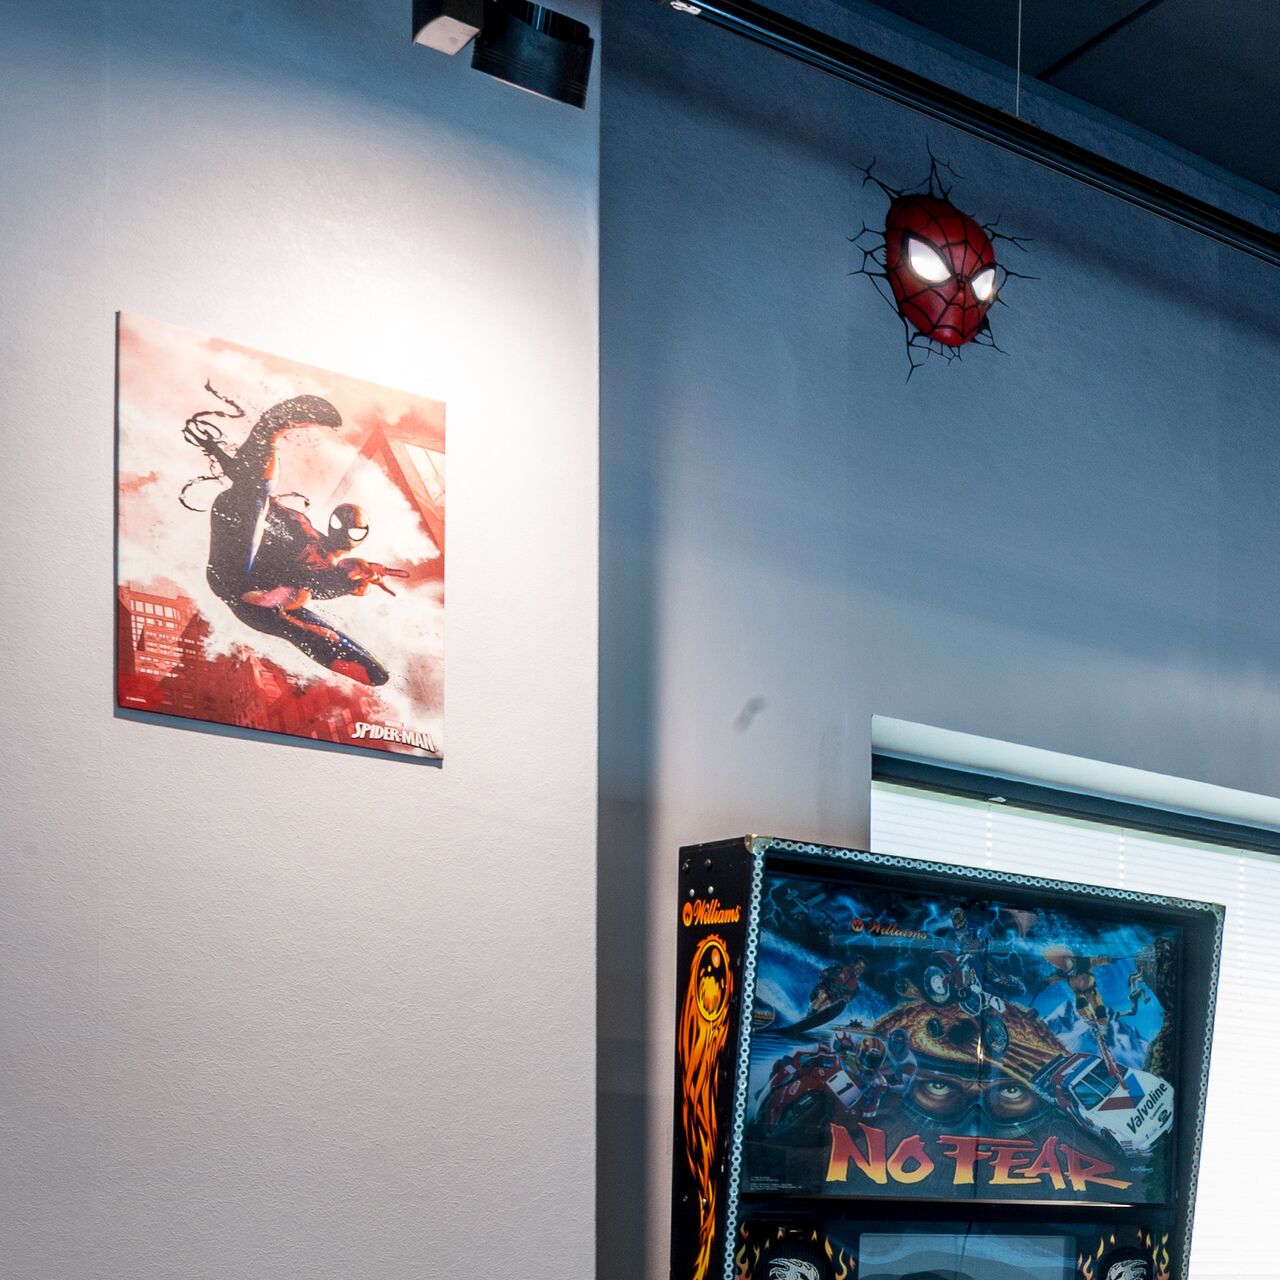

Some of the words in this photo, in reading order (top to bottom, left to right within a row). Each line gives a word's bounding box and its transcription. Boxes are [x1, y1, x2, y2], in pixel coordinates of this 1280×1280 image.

[352, 721, 437, 753] SPIDER-MAN
[693, 899, 741, 925] Williams
[868, 921, 928, 940] Williams
[1126, 1082, 1168, 1134] Valvoline
[825, 1122, 935, 1185] NO
[936, 1134, 1133, 1192] FEAR
